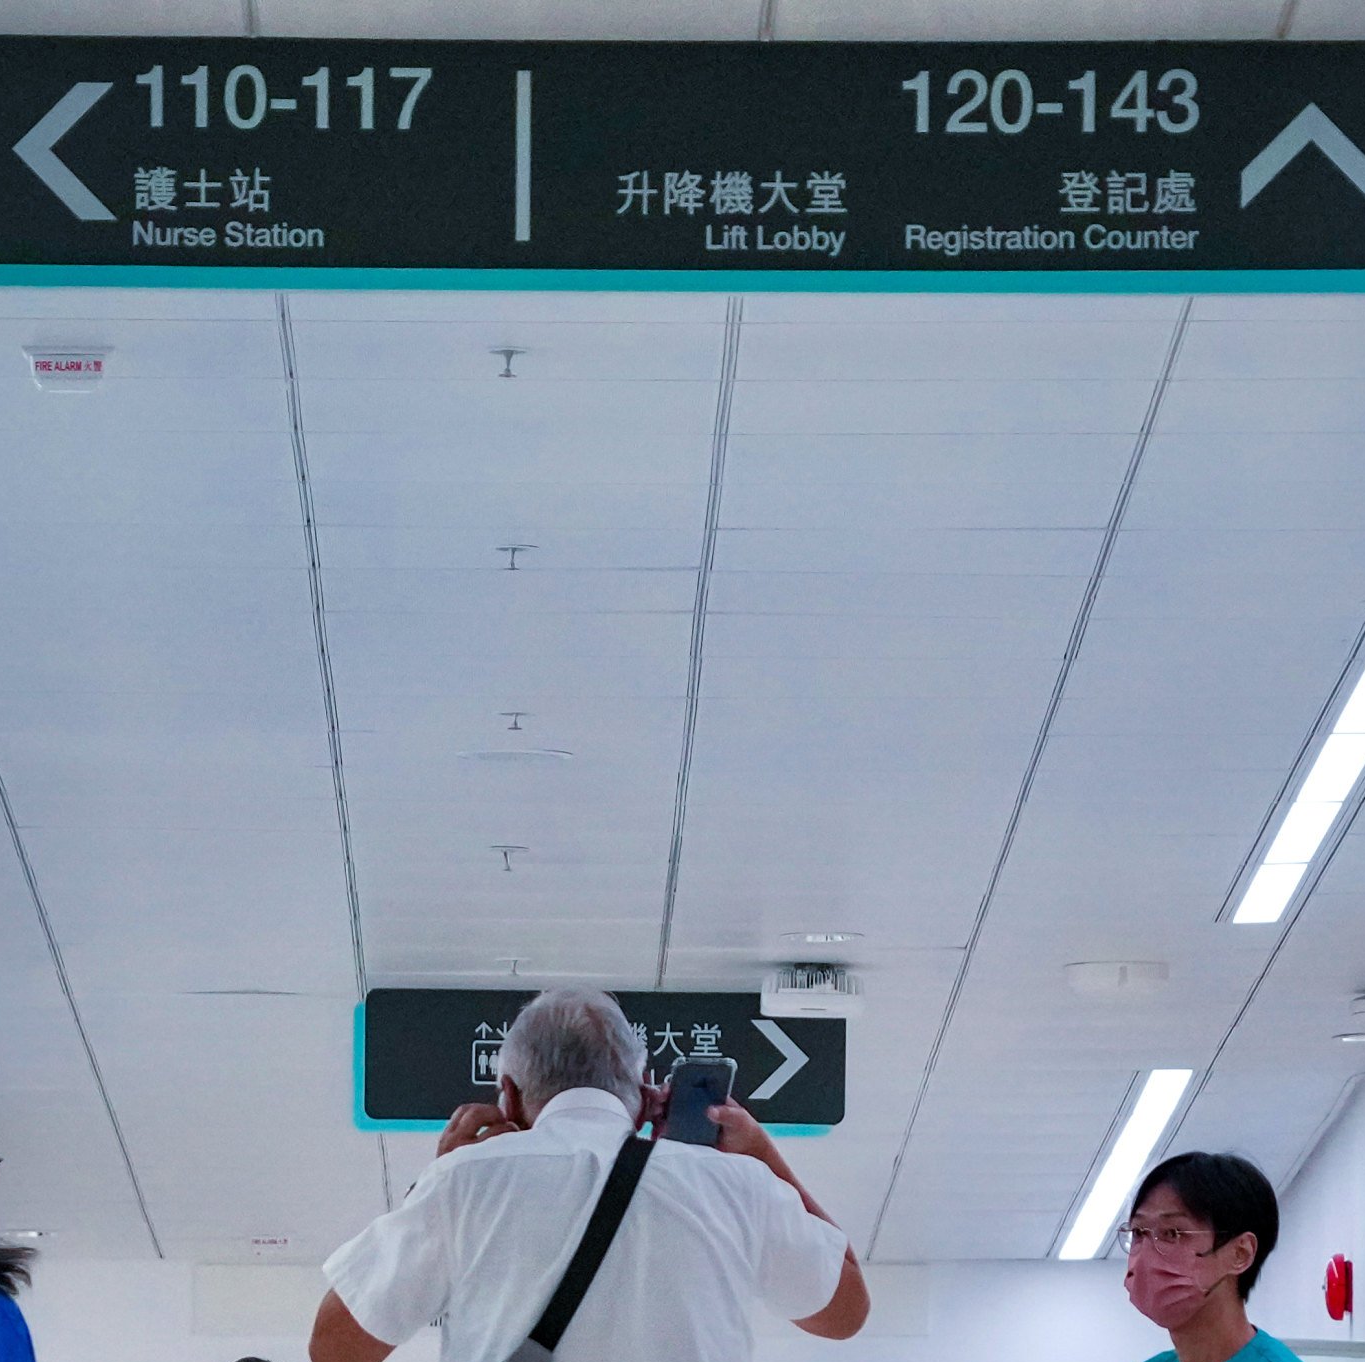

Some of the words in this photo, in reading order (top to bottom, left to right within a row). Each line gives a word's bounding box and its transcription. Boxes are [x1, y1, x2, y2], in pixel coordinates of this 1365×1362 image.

[135, 64, 433, 131] 110-117
[902, 69, 1200, 134] 120-143
[134, 167, 272, 213] 護士站
[616, 170, 848, 216] 升降機大堂
[1059, 171, 1198, 215] 登記處
[134, 222, 217, 248] Nurse
[225, 222, 325, 249] Station
[706, 223, 748, 250] Lift
[756, 223, 846, 256] Lobby
[905, 223, 1076, 256] Registration
[1085, 224, 1199, 251] Counter
[35, 361, 53, 371] FIRE
[55, 361, 82, 371] ALARM
[632, 1022, 723, 1056] 大堂
